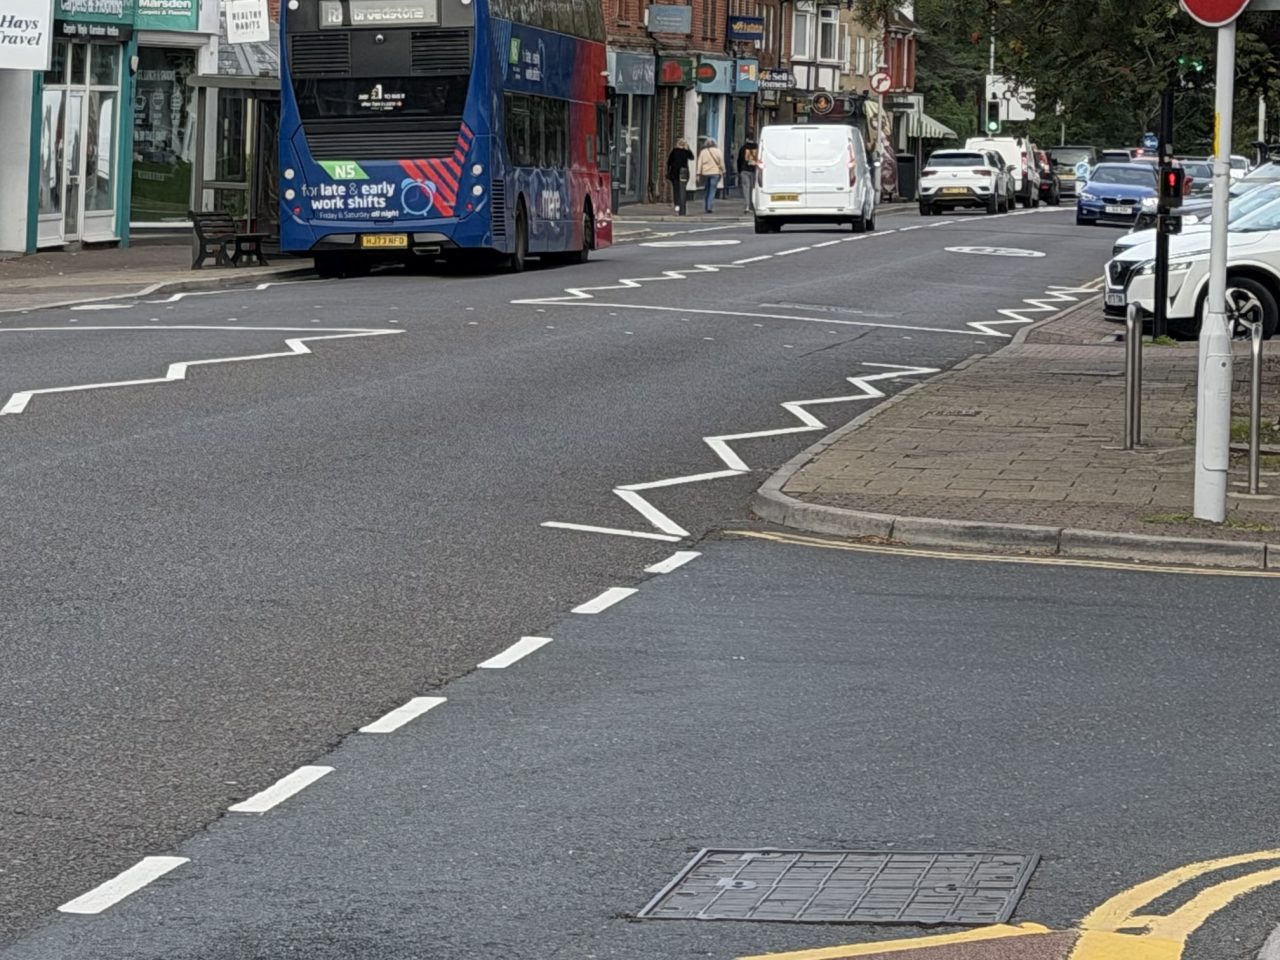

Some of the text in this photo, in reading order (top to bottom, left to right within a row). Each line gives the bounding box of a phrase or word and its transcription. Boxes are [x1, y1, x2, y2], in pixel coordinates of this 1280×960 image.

[232, 10, 262, 21] HEALTHY
[0, 15, 40, 32] Hays
[235, 21, 260, 30] HABITS
[335, 165, 356, 178] N5
[301, 182, 395, 197] for late & early
[311, 196, 386, 209] work shifts
[344, 211, 370, 219] Saturday
[380, 209, 399, 218] night
